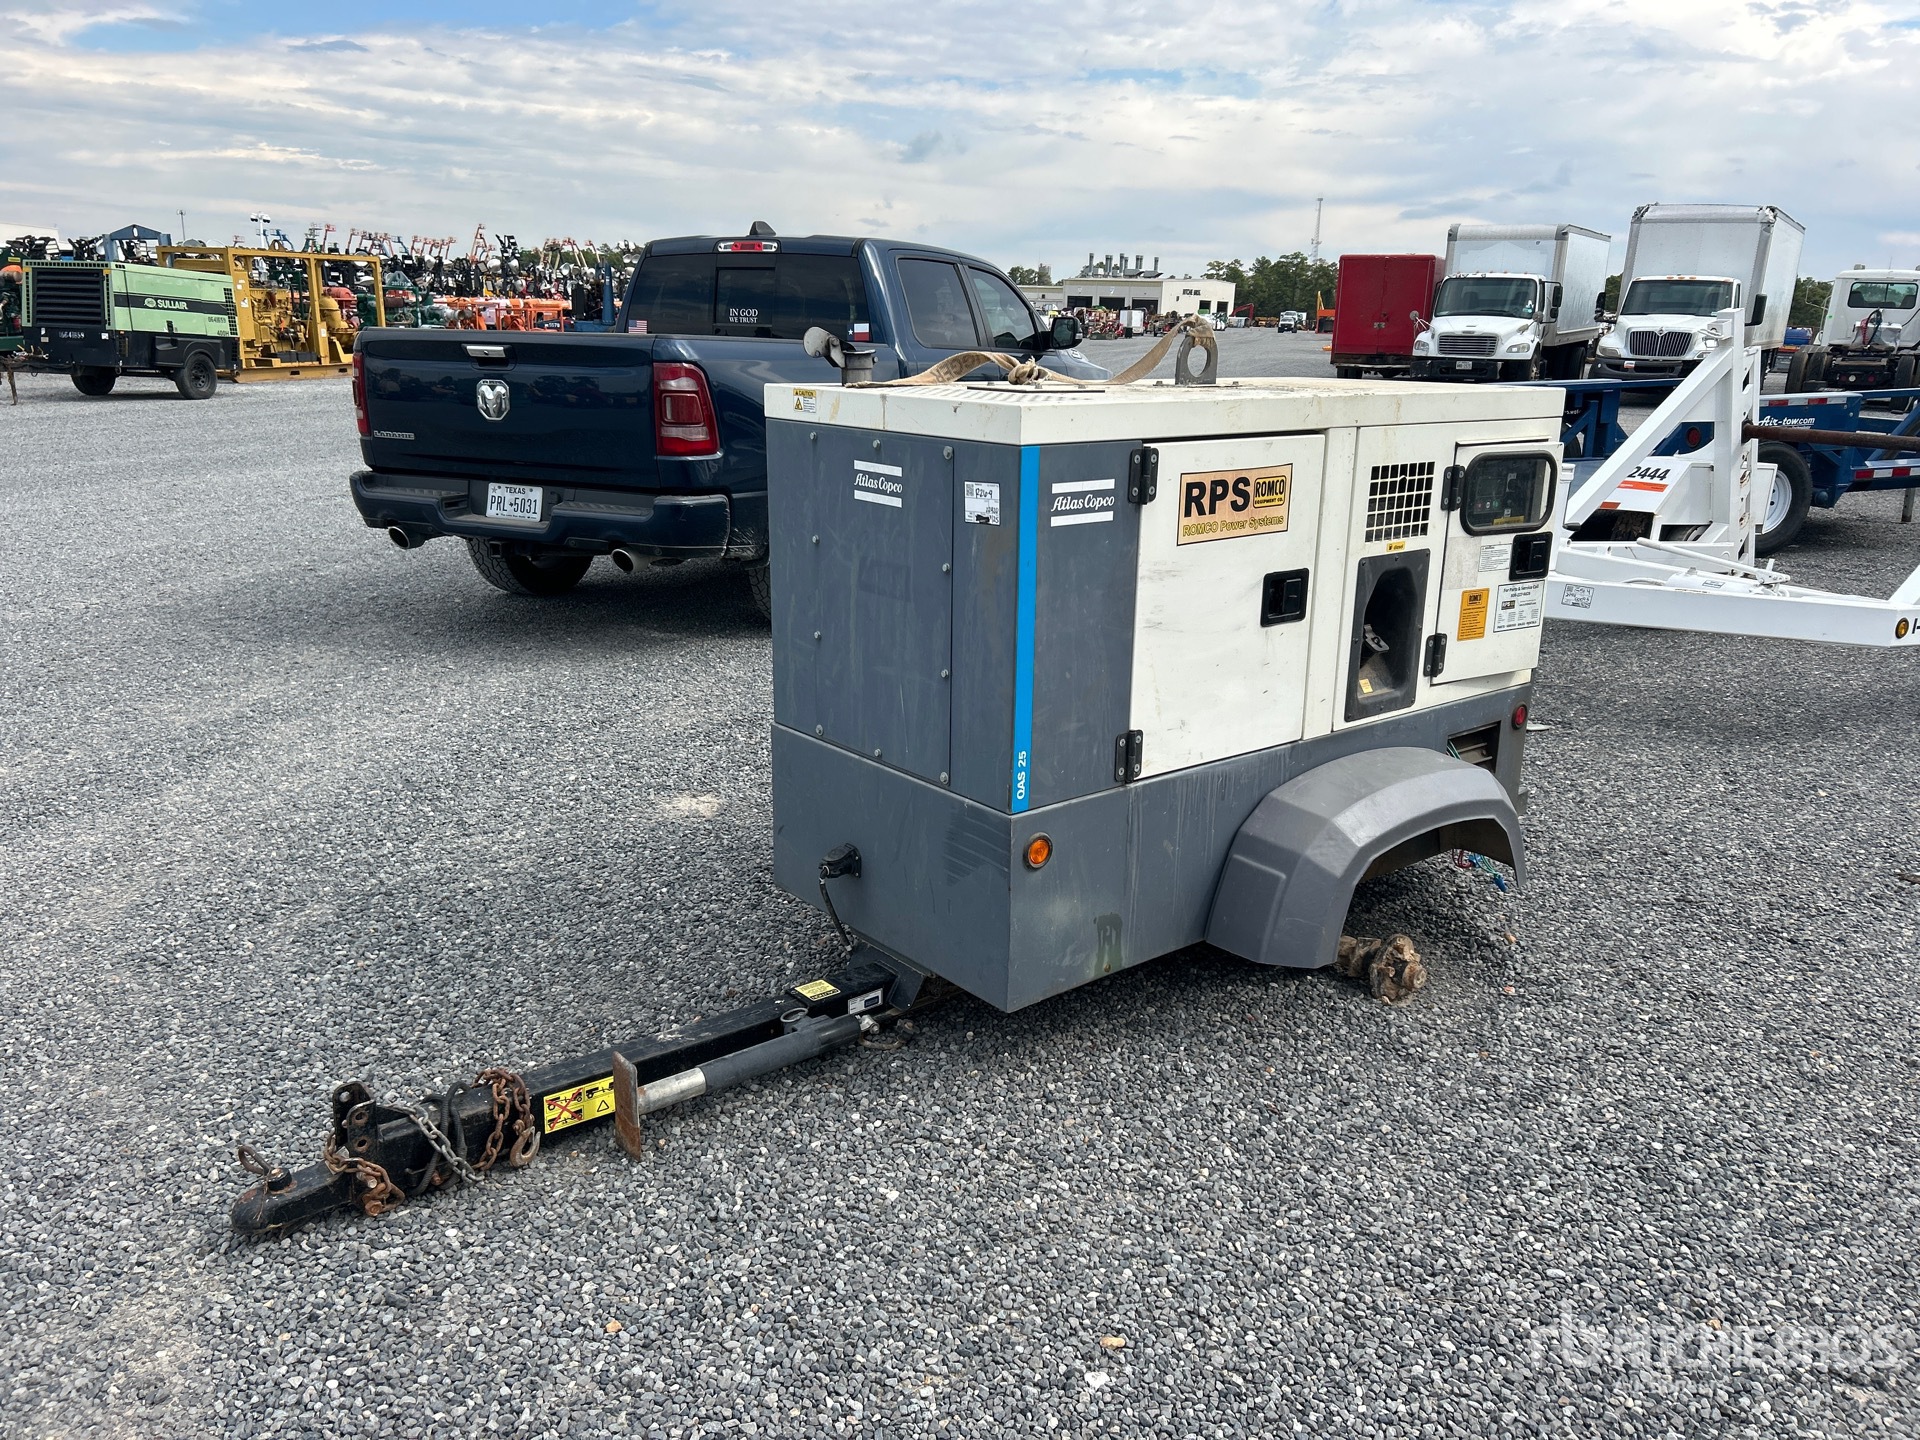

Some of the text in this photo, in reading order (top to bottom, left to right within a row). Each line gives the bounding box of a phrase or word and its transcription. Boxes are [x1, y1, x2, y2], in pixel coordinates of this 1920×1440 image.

[158, 300, 188, 310] SULLAIR
[729, 308, 759, 317] IN GOD
[373, 430, 415, 440] LARAMIE
[1626, 466, 1672, 481] 2444
[505, 486, 526, 494] TEXAS
[854, 473, 903, 494] Atlas Copco
[1255, 479, 1285, 498] ROMCO
[1050, 493, 1115, 512] Atlas Copco
[1184, 476, 1251, 518] RPS
[1254, 497, 1277, 505] EQUIPMENT
[1183, 515, 1284, 537] ROMCO Power Systems
[1016, 750, 1027, 800] QAS 25
